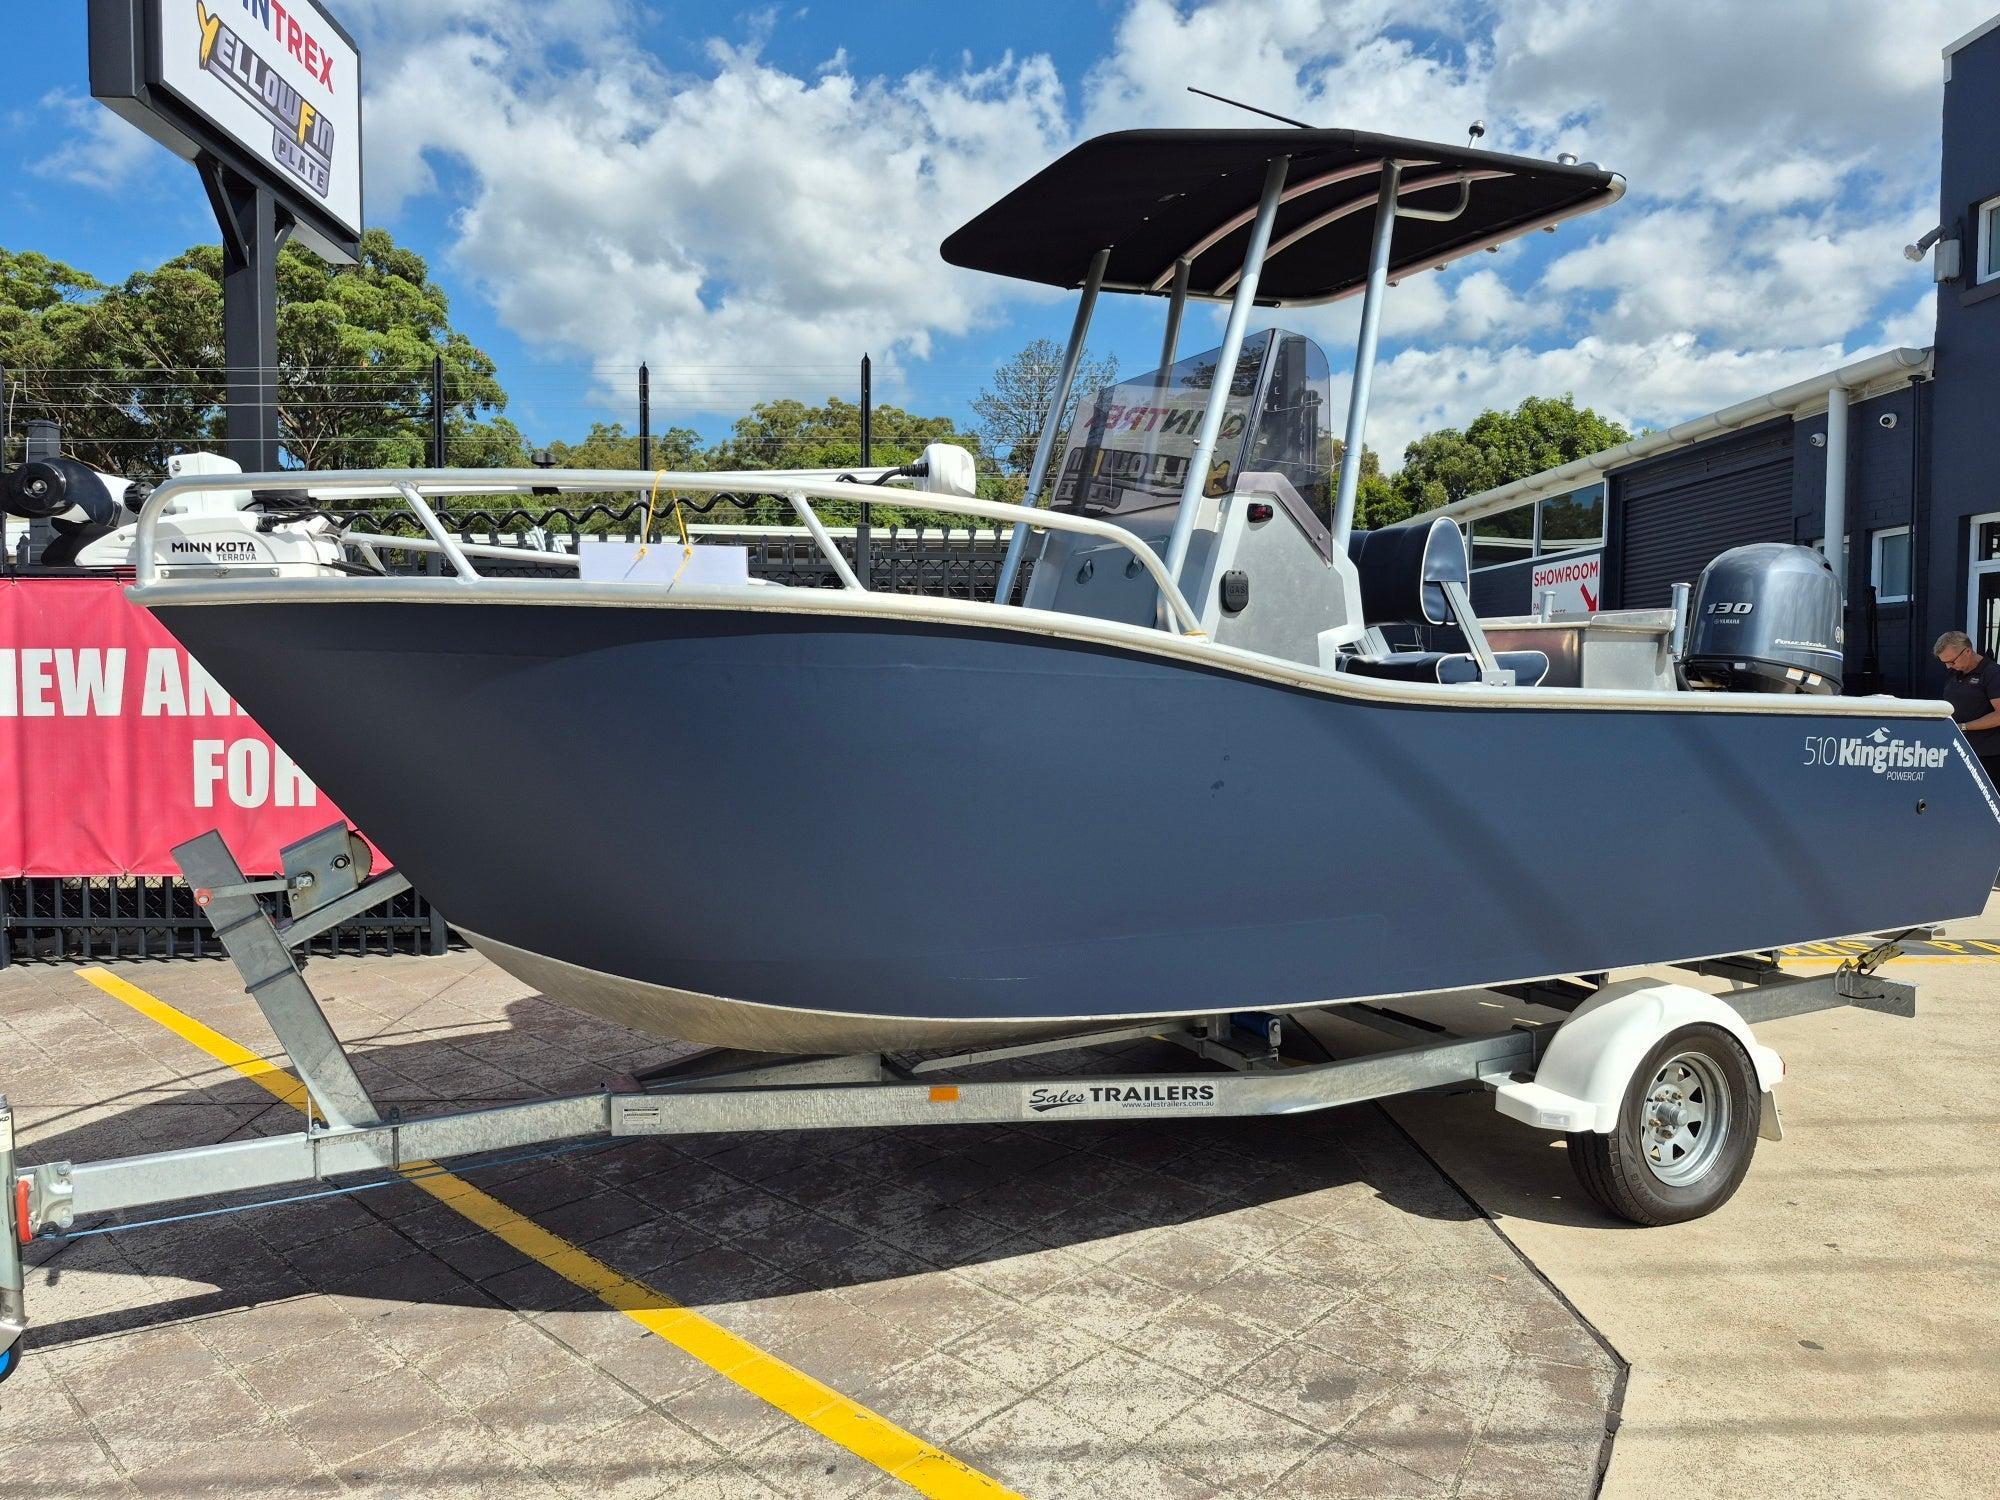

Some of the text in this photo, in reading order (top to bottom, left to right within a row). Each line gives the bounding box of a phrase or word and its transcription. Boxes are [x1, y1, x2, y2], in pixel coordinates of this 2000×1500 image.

[243, 0, 334, 95] NTREX
[279, 140, 327, 189] PLATE
[172, 542, 256, 553] MINN KOTA
[217, 553, 257, 561] TERROVA
[1534, 561, 1598, 587] SHOWROOM
[1707, 602, 1753, 614] 130
[141, 648, 250, 716] AN
[1804, 737, 1948, 774] 510 Kingfisher
[1886, 771, 1925, 781] POWERCAT
[1029, 1085, 1214, 1104] Sales TRAILERS
[1121, 1100, 1214, 1108] www.salestrailers.com.au
